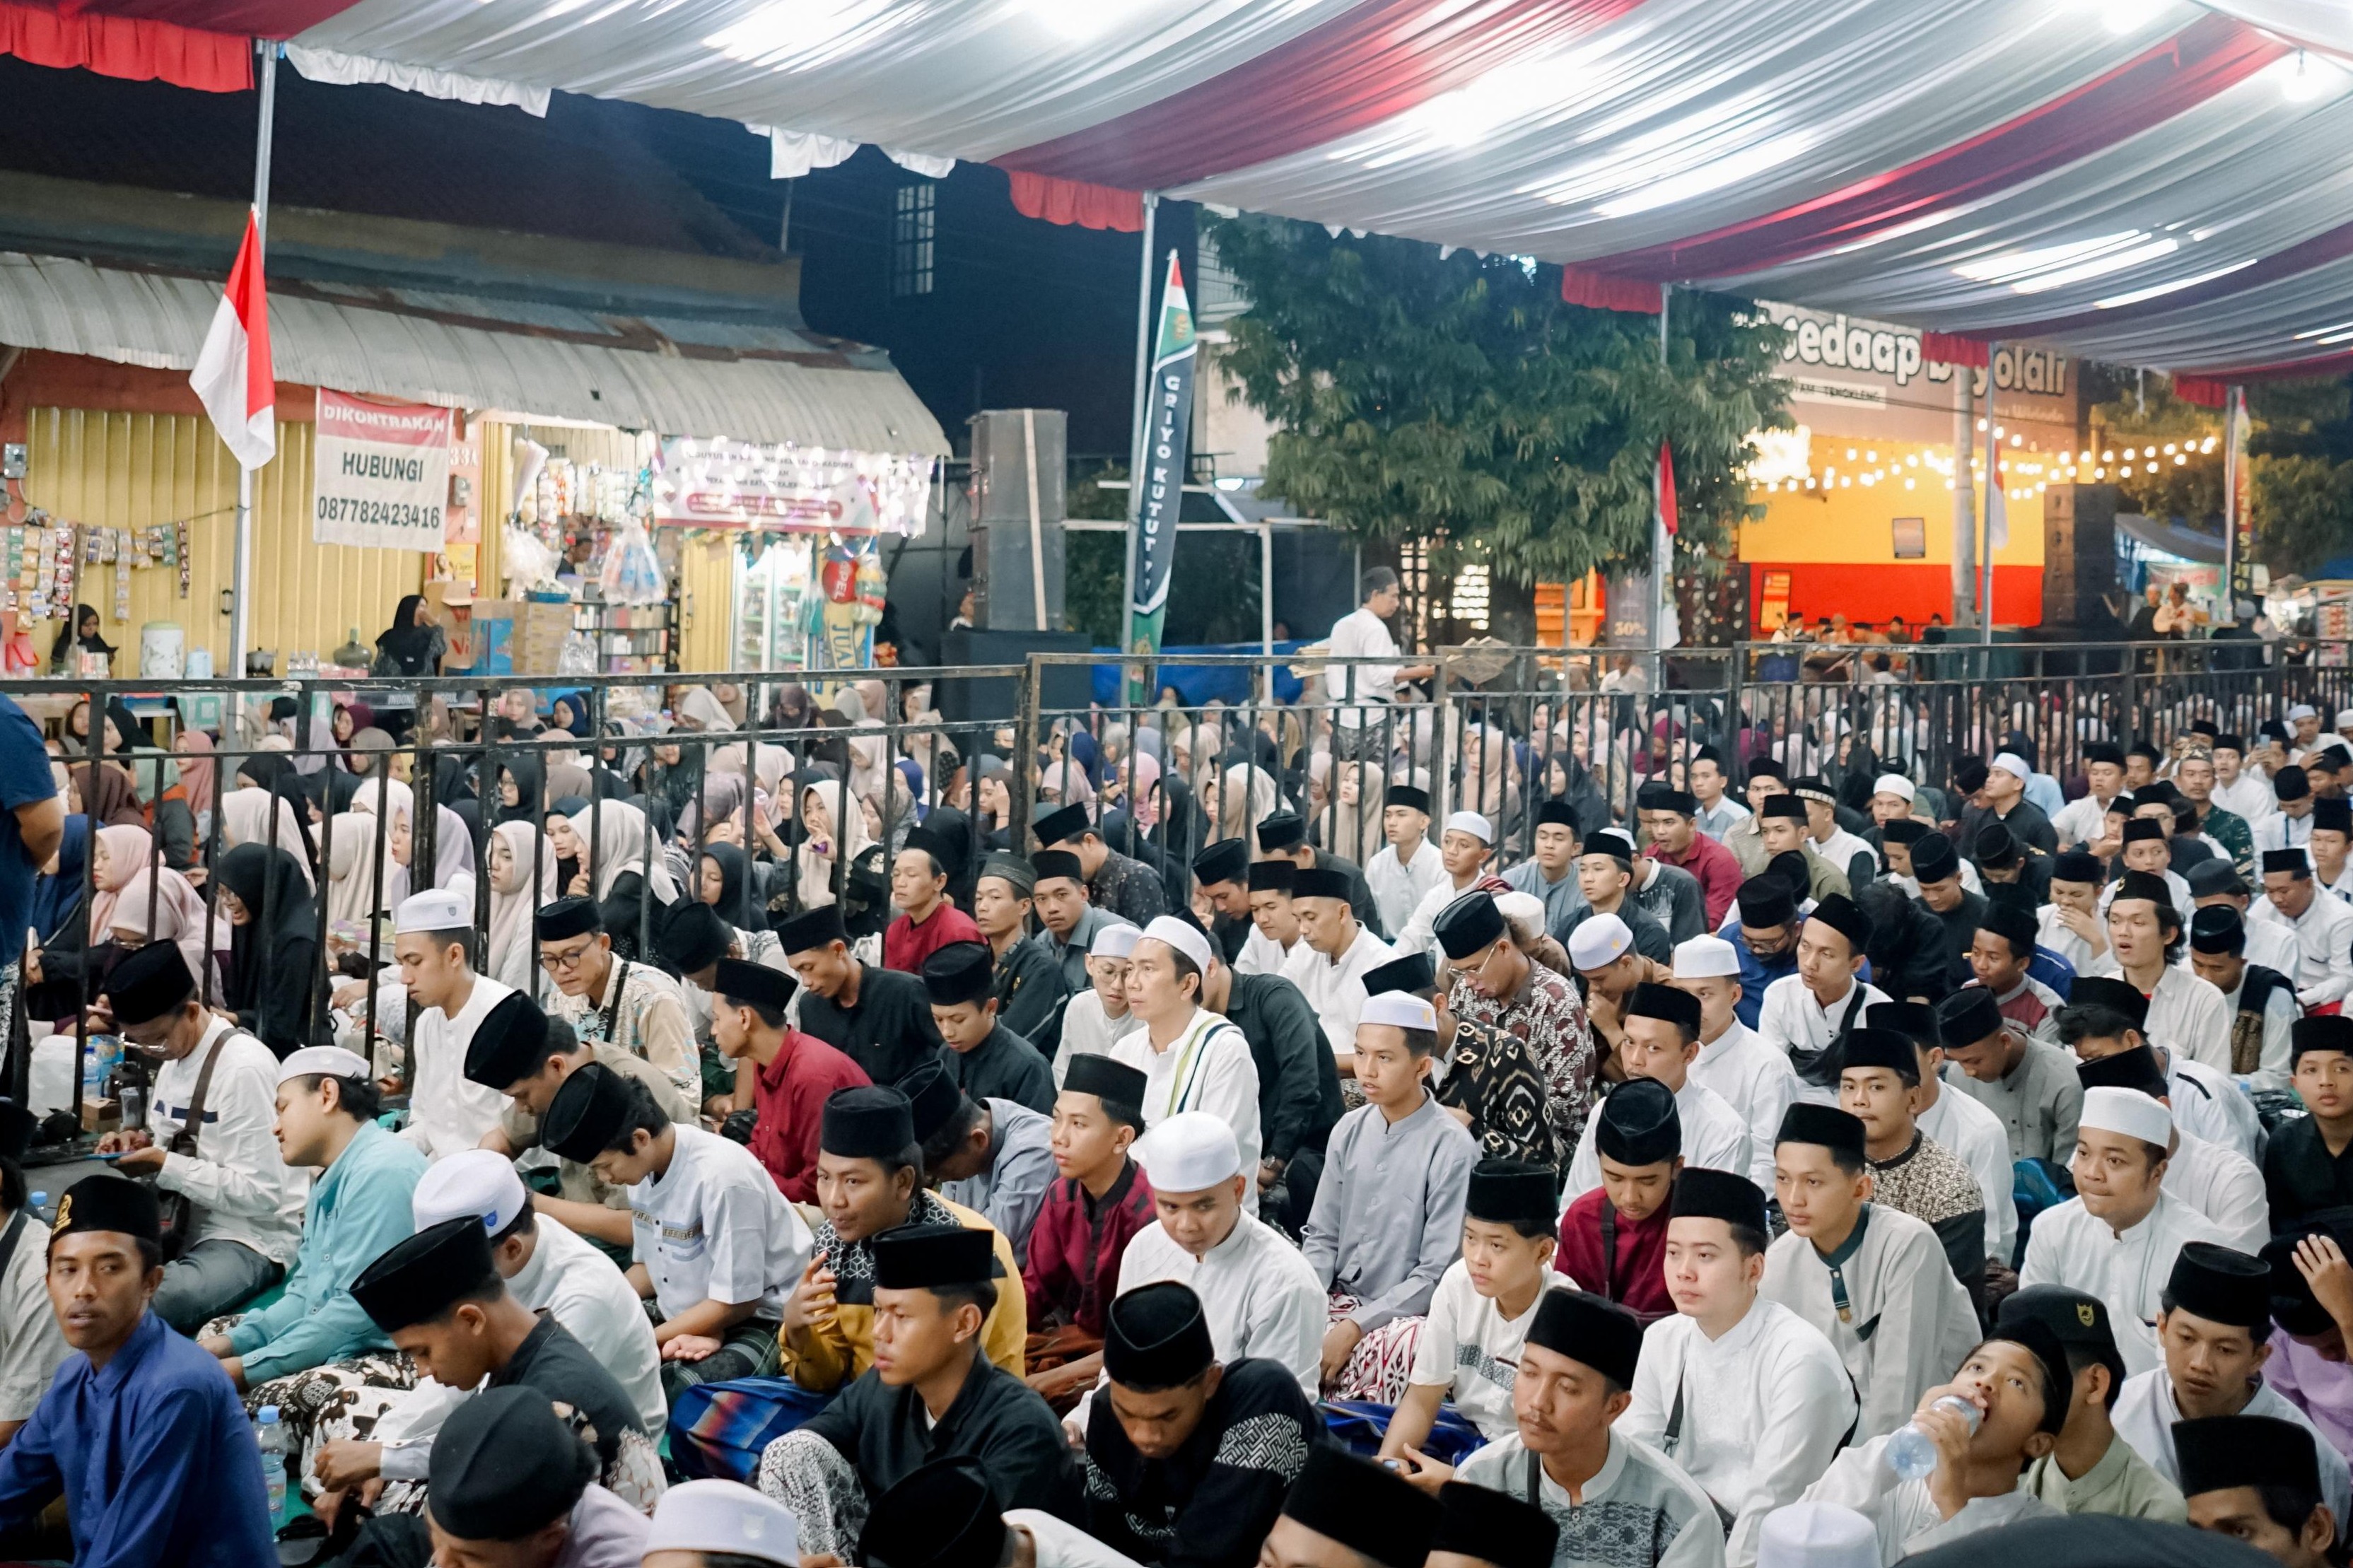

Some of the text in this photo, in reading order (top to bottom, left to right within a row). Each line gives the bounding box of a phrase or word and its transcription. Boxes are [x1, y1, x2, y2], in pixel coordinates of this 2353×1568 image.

[1929, 346, 2067, 398] yolali
[324, 405, 445, 433] DIKONTRAKAN
[1156, 375, 1181, 460] GRIYO
[342, 452, 424, 482] HUBUNGI
[450, 446, 477, 467] 33A
[318, 496, 440, 529] 087782423416
